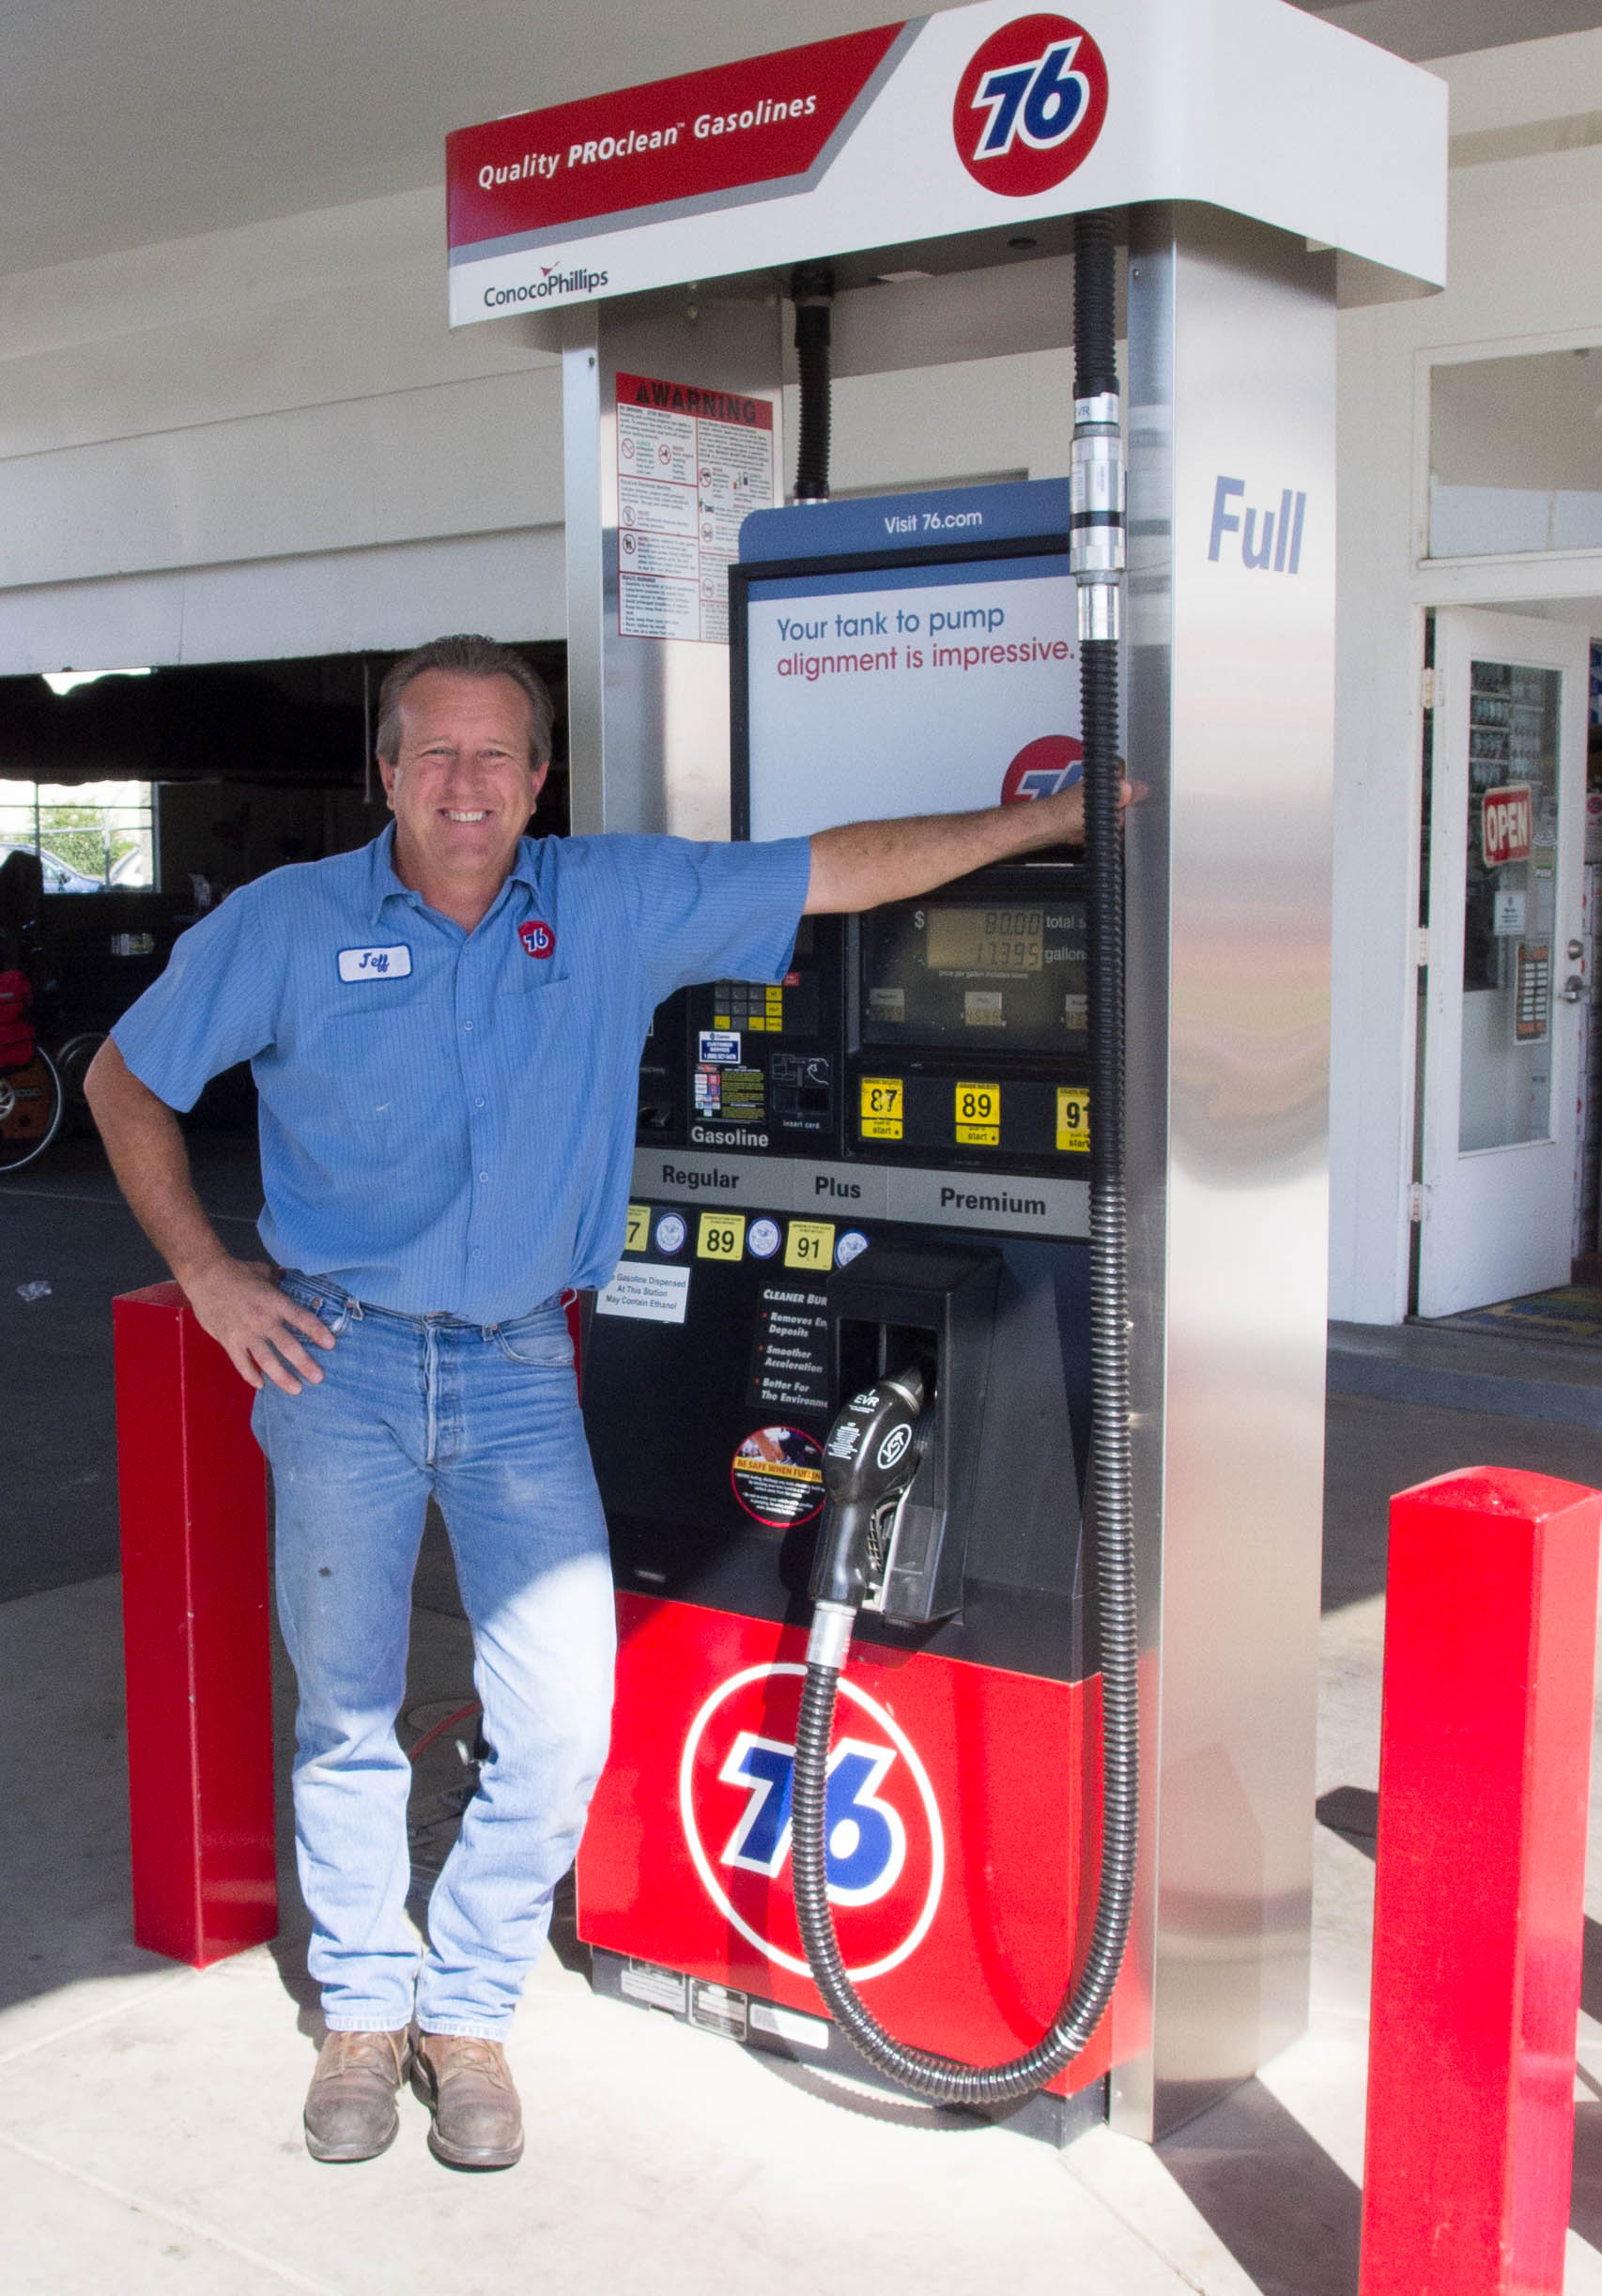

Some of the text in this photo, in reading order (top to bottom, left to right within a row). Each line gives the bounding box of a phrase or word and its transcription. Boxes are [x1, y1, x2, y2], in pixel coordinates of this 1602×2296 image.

[971, 36, 1089, 161] 76
[478, 151, 560, 189] Quality
[693, 95, 817, 139] Gasolines
[484, 271, 608, 308] ConocoPhillips
[652, 382, 756, 424] WARNING
[884, 510, 983, 534] Visit 76.com
[1208, 475, 1306, 575] Full
[777, 606, 1005, 641] Your tank to pump
[776, 637, 1075, 681] alignment is impressive.
[1487, 801, 1528, 852] OPEN
[1046, 916, 1074, 929] total
[523, 928, 548, 952] 76
[359, 952, 390, 973] Jeff
[870, 1088, 898, 1112] 87
[963, 1093, 992, 1117] 89
[691, 1127, 769, 1148] Gasoline
[662, 1164, 739, 1190] Regular
[815, 1177, 861, 1198] Plus
[940, 1187, 1046, 1216] Premium
[626, 1222, 640, 1243] 7
[707, 1229, 734, 1253] 89
[798, 1237, 819, 1258] 91
[617, 1273, 686, 1287] Gasoline Dispensed
[618, 1285, 668, 1297] At This Station
[763, 1288, 805, 1303] CLEANER
[606, 1295, 677, 1309] May Contain Ethanol
[770, 1311, 812, 1325] Removes
[769, 1323, 809, 1337] Deposits
[766, 1345, 811, 1359] Smoother
[764, 1357, 824, 1373] Acceleration
[762, 1377, 810, 1393] Better For
[762, 1389, 778, 1401] The
[854, 1394, 880, 1407] EVR
[883, 1431, 904, 1463] VST
[737, 1459, 747, 1468] BE
[748, 1461, 765, 1470] SAFE
[769, 1464, 791, 1474] WHEN
[718, 1731, 906, 1907] 76
